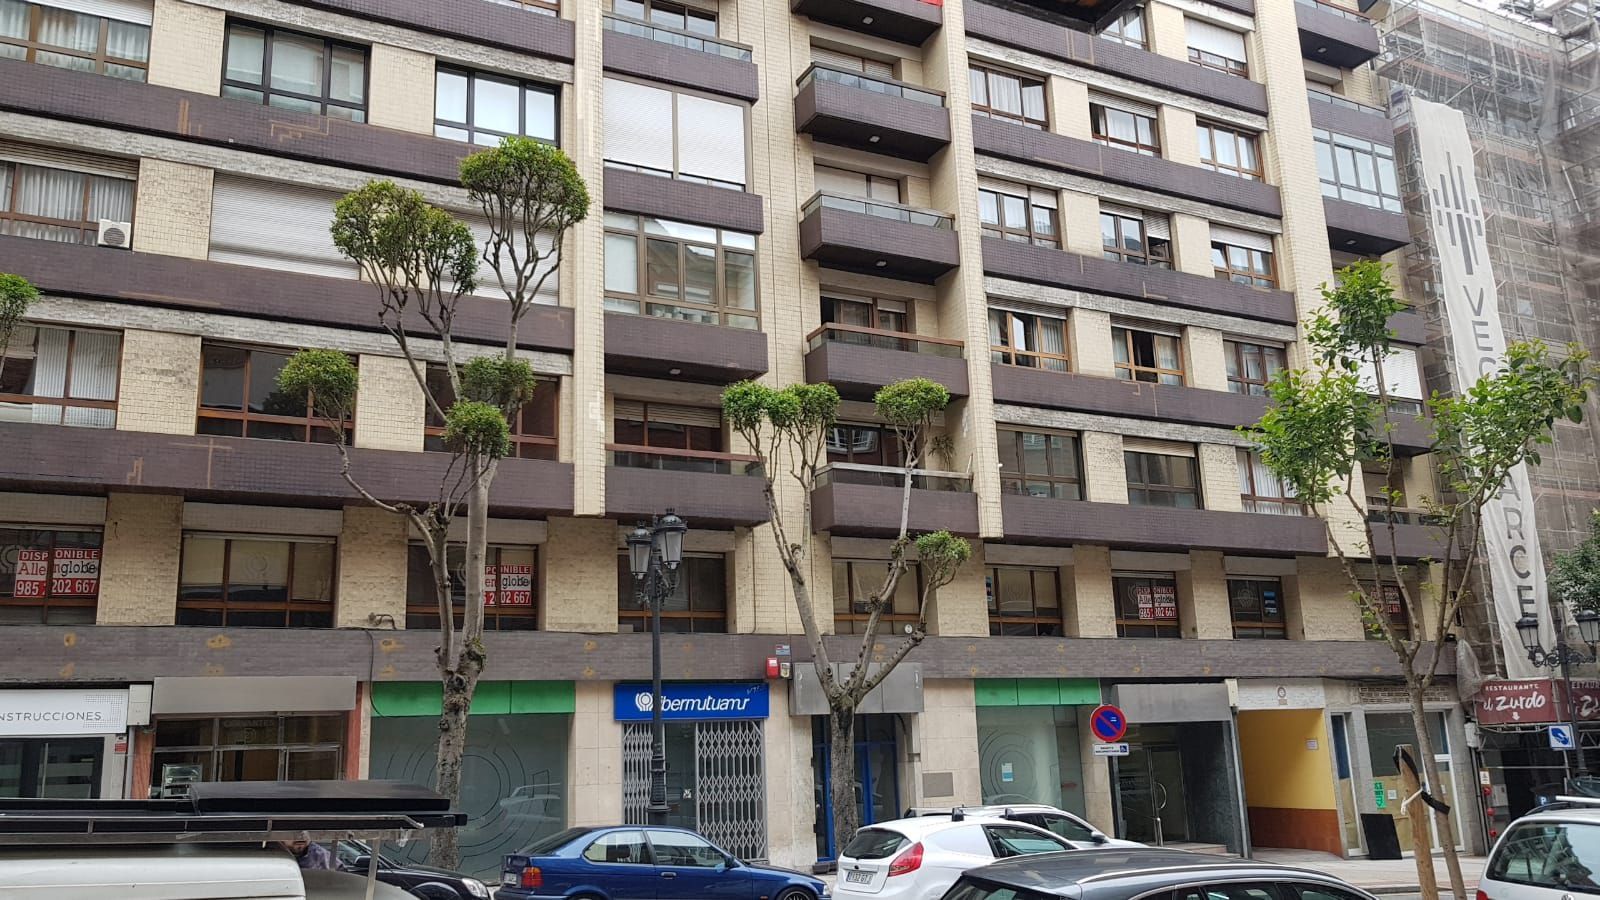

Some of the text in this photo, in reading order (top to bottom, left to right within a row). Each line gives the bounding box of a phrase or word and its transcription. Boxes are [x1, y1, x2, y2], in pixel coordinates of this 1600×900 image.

[21, 550, 98, 560] DISPONIBLE
[486, 566, 529, 574] PONIBLE
[17, 582, 39, 596] 985
[75, 579, 96, 593] 667
[513, 592, 530, 603] 667
[1485, 683, 1540, 691] RESTAURANTE
[1495, 691, 1546, 711] Zurdo
[0, 711, 102, 721] NSTRUCCIONES
